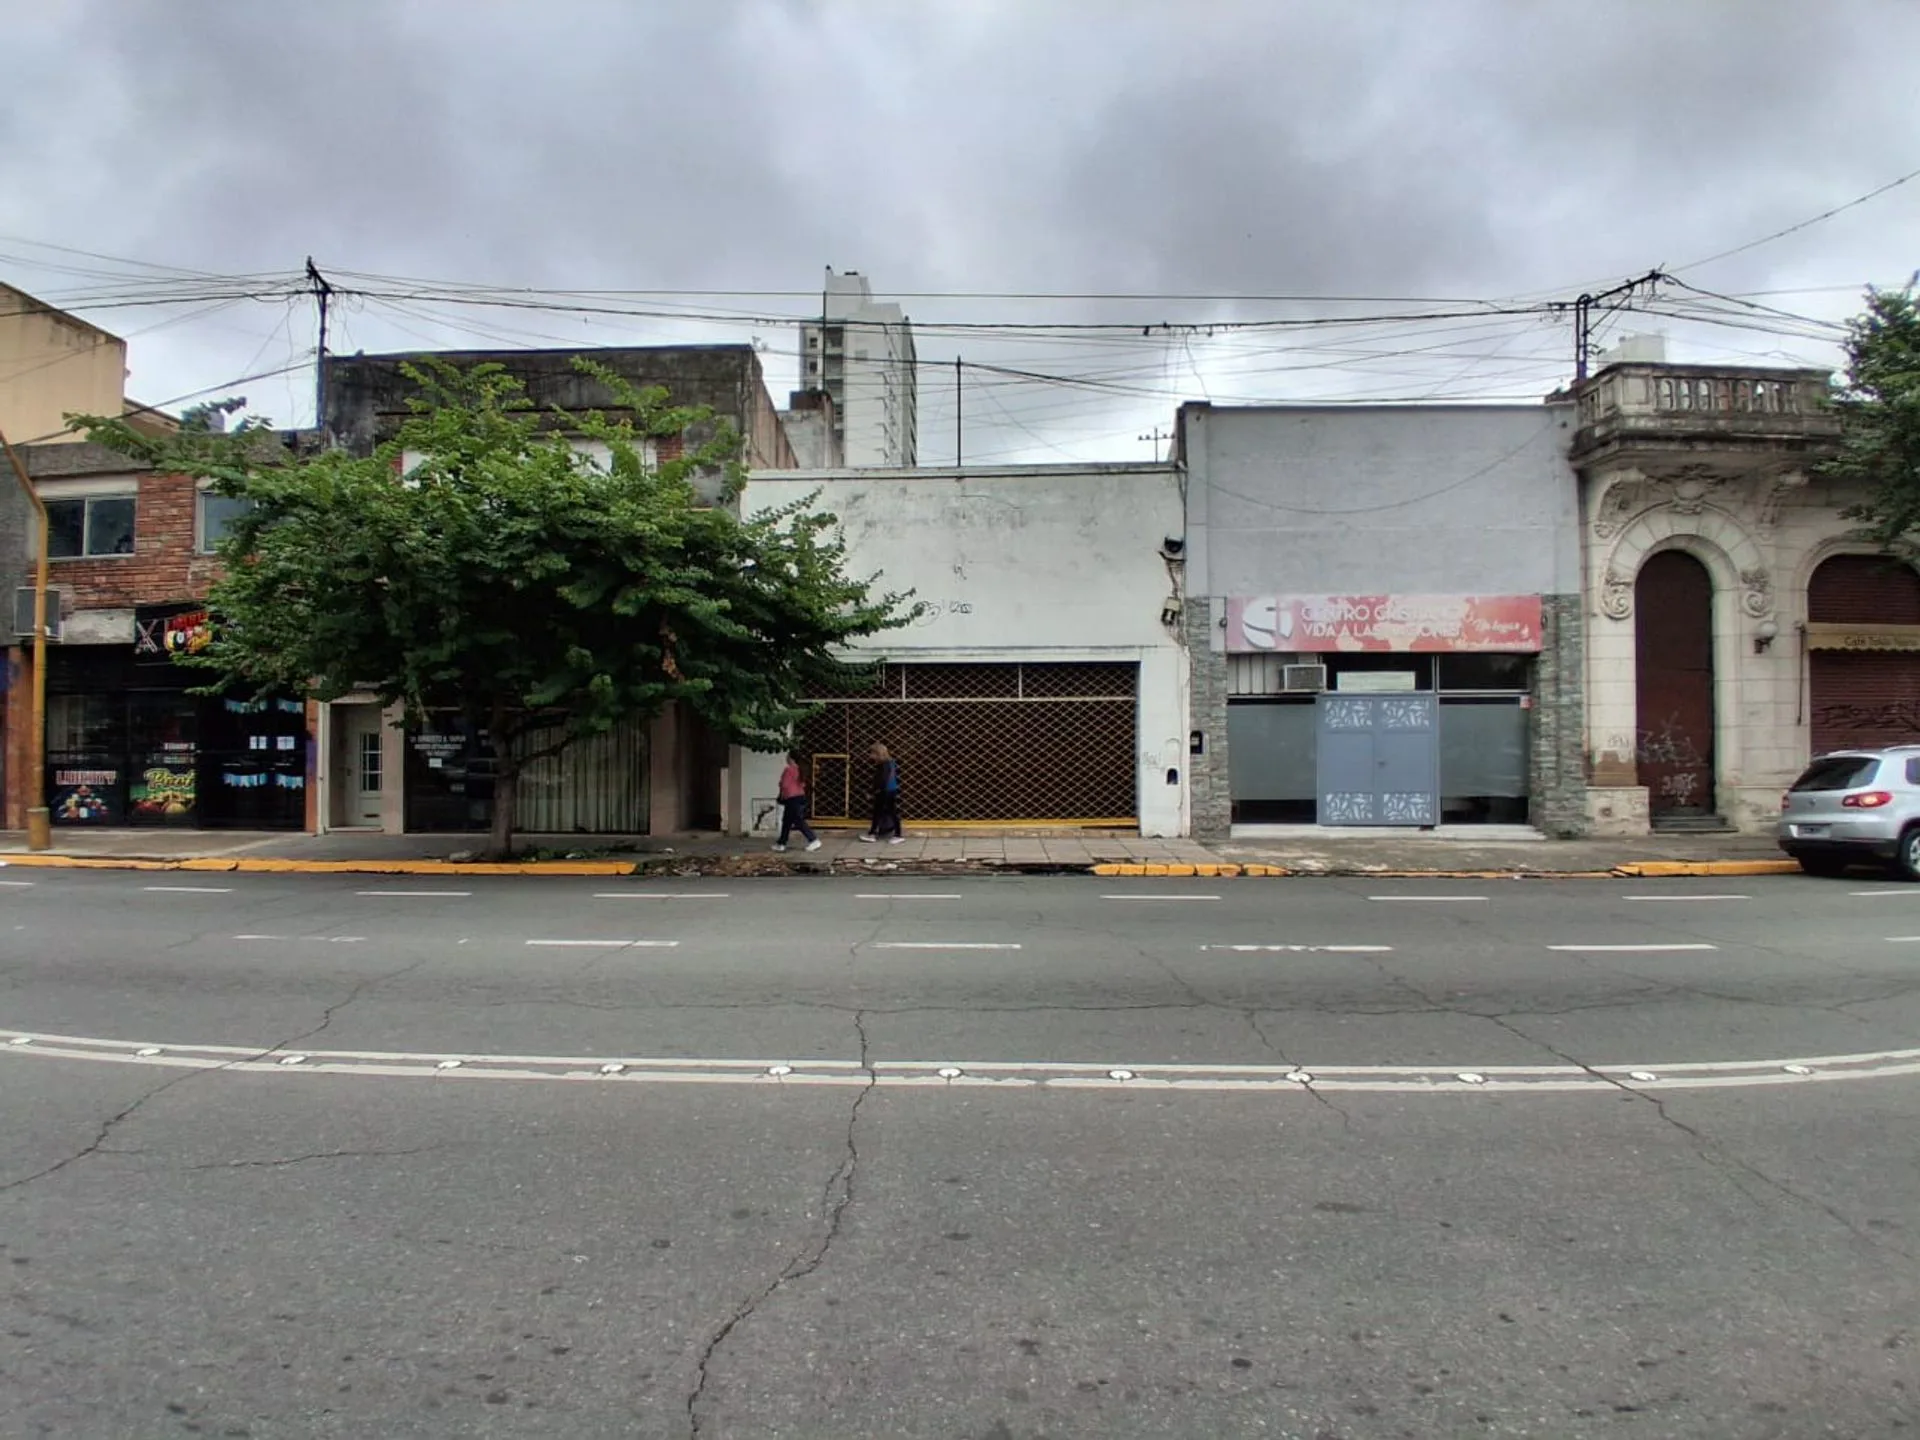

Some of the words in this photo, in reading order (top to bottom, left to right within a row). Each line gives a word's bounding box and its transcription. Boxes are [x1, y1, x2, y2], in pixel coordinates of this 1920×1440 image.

[1301, 604, 1370, 621] CENTRO
[1303, 622, 1336, 637] VIDA
[1340, 622, 1351, 637] A
[1384, 622, 1461, 637] CIONES
